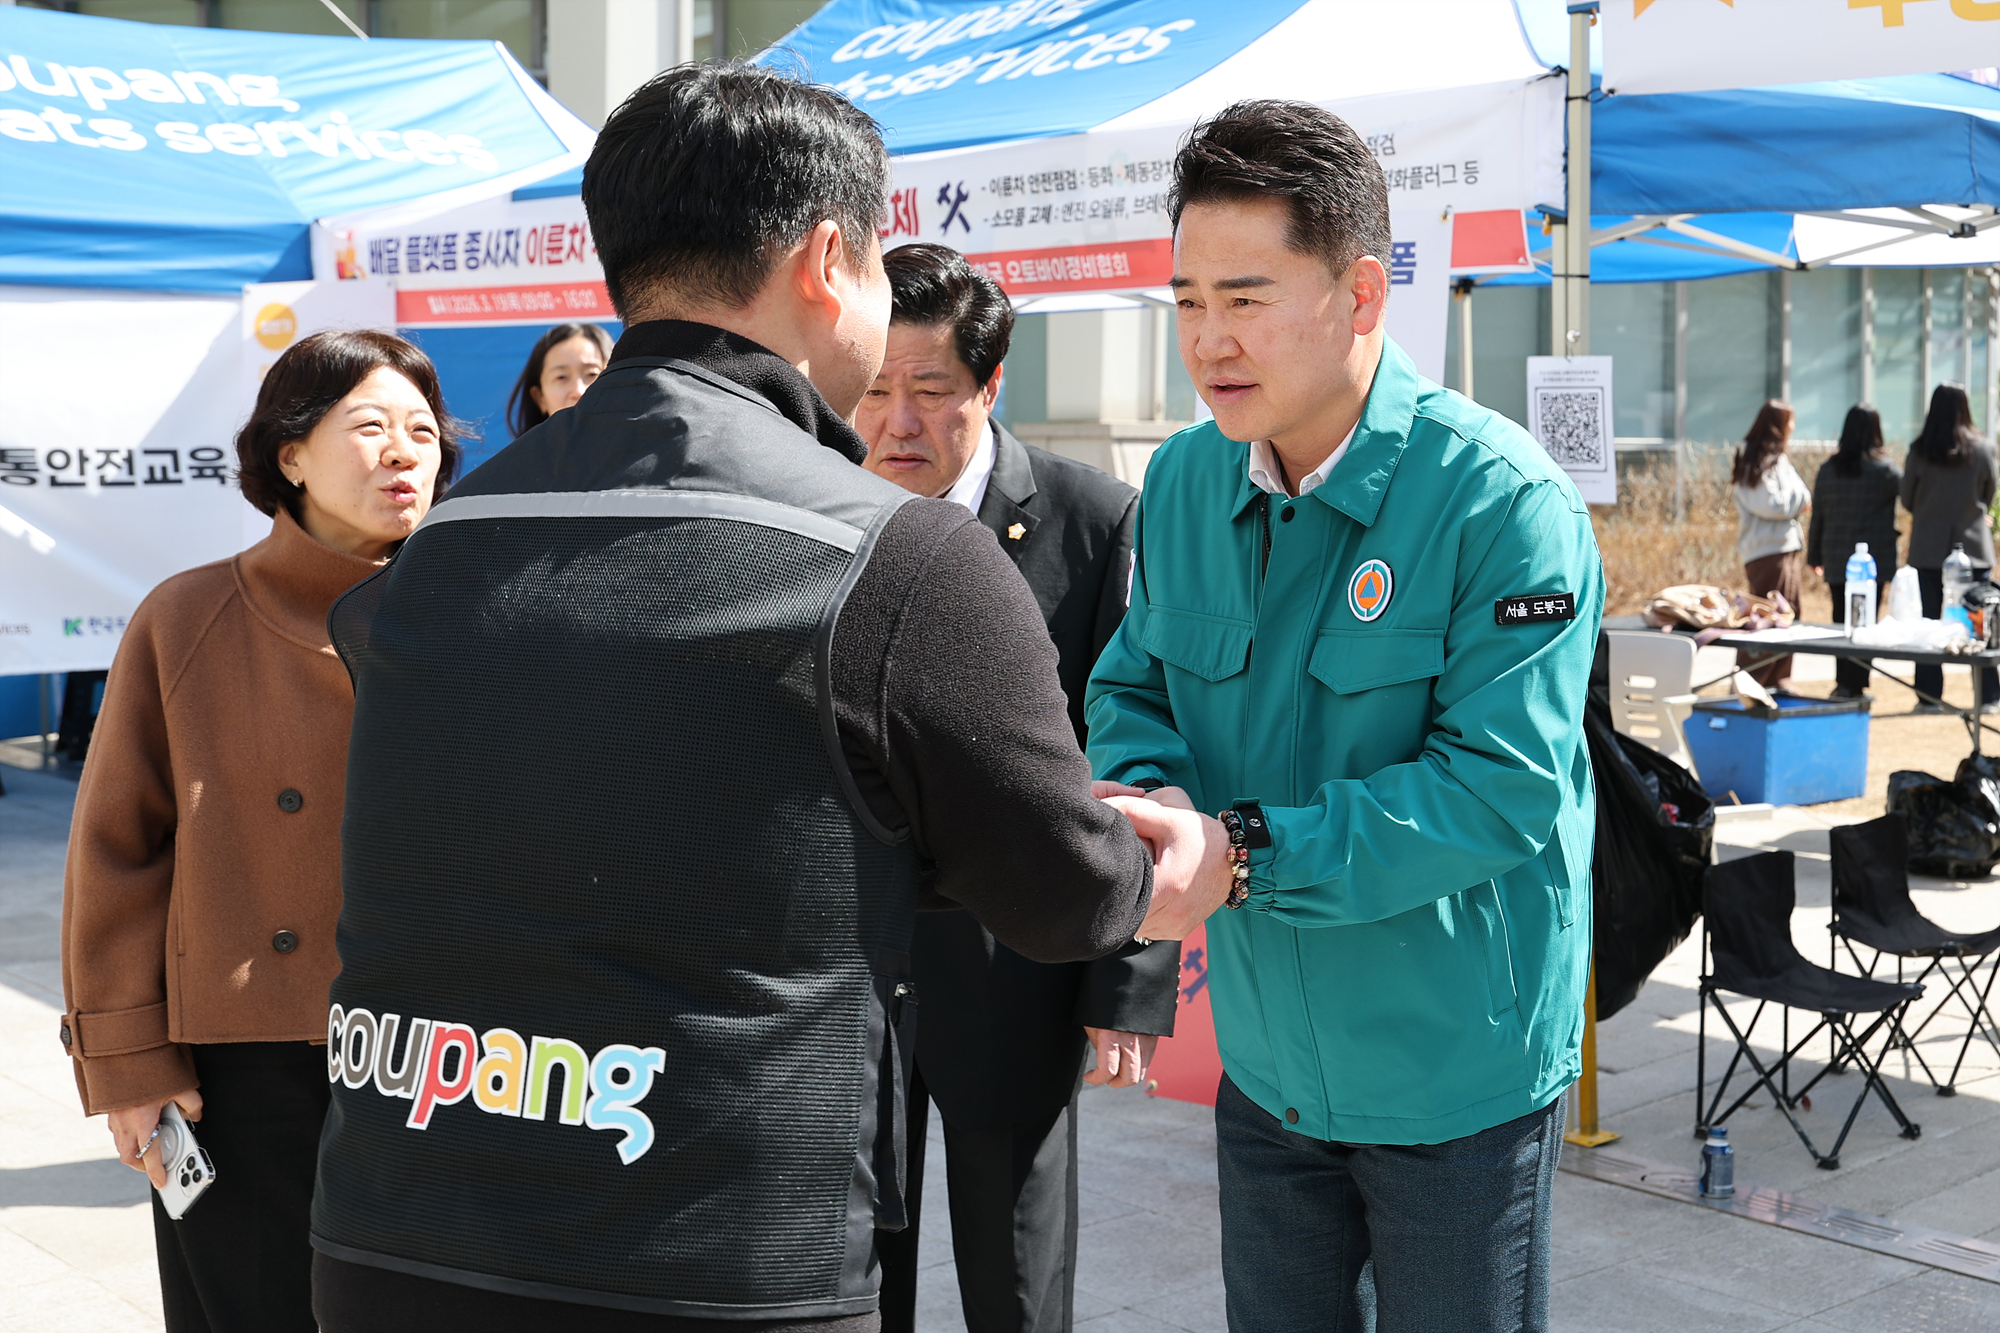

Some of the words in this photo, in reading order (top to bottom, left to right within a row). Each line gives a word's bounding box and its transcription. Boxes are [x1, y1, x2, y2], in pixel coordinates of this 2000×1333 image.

[864, 19, 1196, 101] services
[155, 111, 499, 172] services
[989, 174, 1025, 196] 이륜차
[1028, 168, 1077, 194] 안전점검
[1088, 165, 1113, 188] 등화
[991, 207, 1025, 228] 소모품
[1029, 204, 1052, 224] 교체
[1463, 160, 1479, 185] 등
[369, 238, 401, 275] 배달
[406, 234, 459, 273] 플랫폼
[464, 228, 521, 269] 종사자
[526, 220, 587, 266] 이륜차
[877, 187, 919, 237] 체
[1006, 251, 1131, 284] 오토바이정비협회
[562, 288, 598, 310] 16:00
[0, 447, 227, 487] 통안전교육
[1505, 602, 1528, 618] 서울
[1533, 599, 1568, 615] 도봉구
[328, 1003, 666, 1166] coupang
